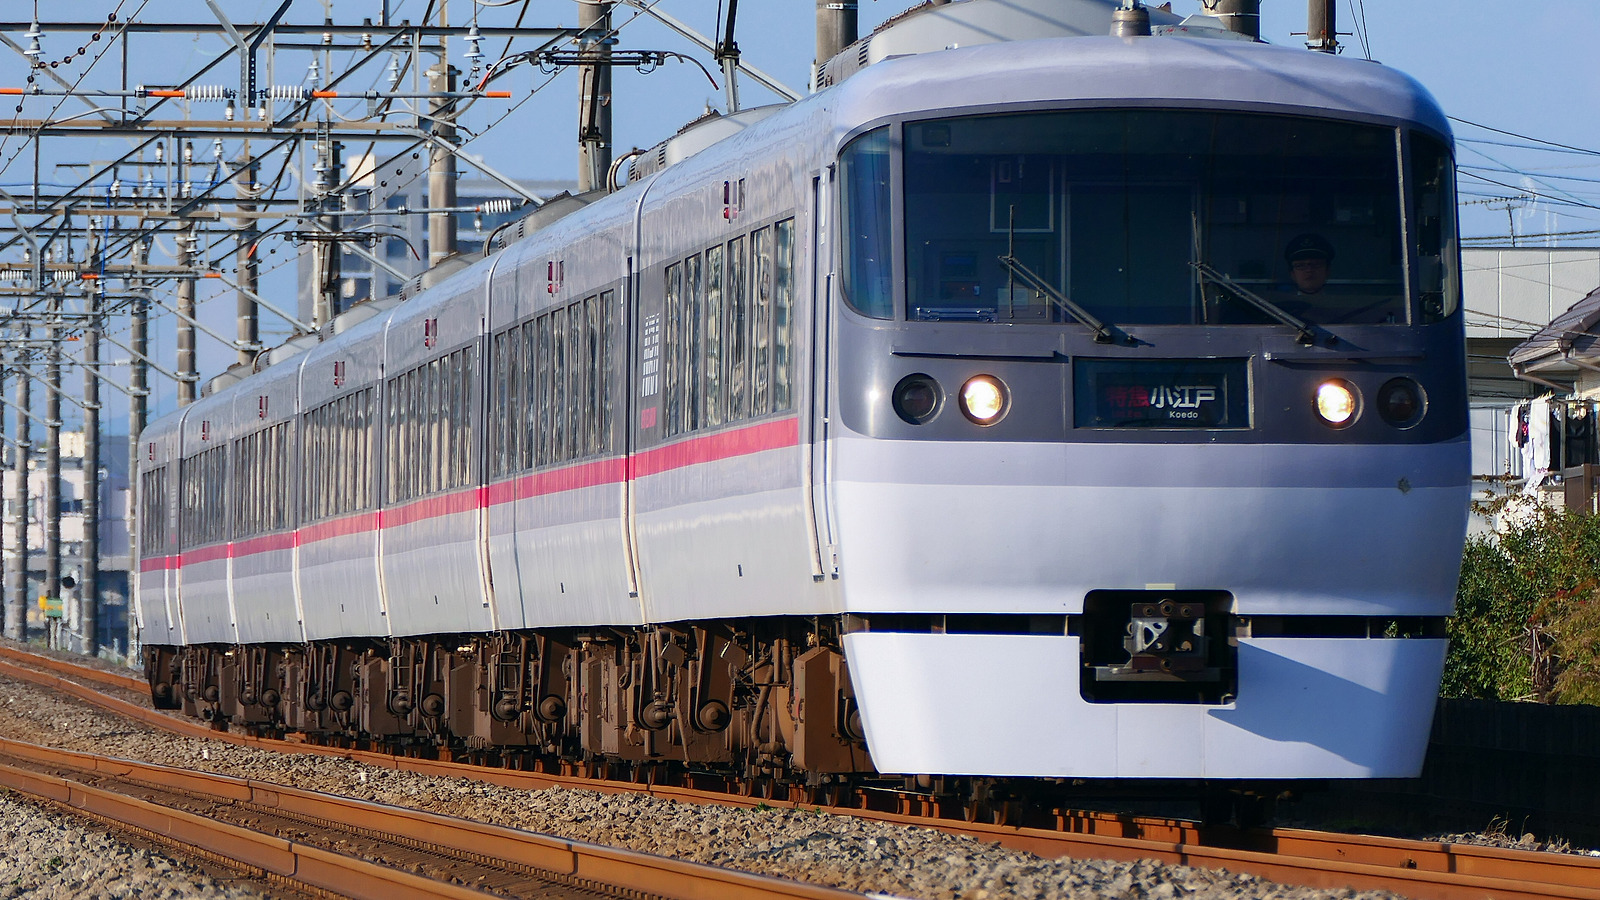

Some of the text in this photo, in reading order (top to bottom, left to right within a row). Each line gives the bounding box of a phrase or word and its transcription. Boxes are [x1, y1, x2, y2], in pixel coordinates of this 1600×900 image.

[1150, 385, 1217, 408] 小江戸
[1169, 410, 1199, 419] Koedo
